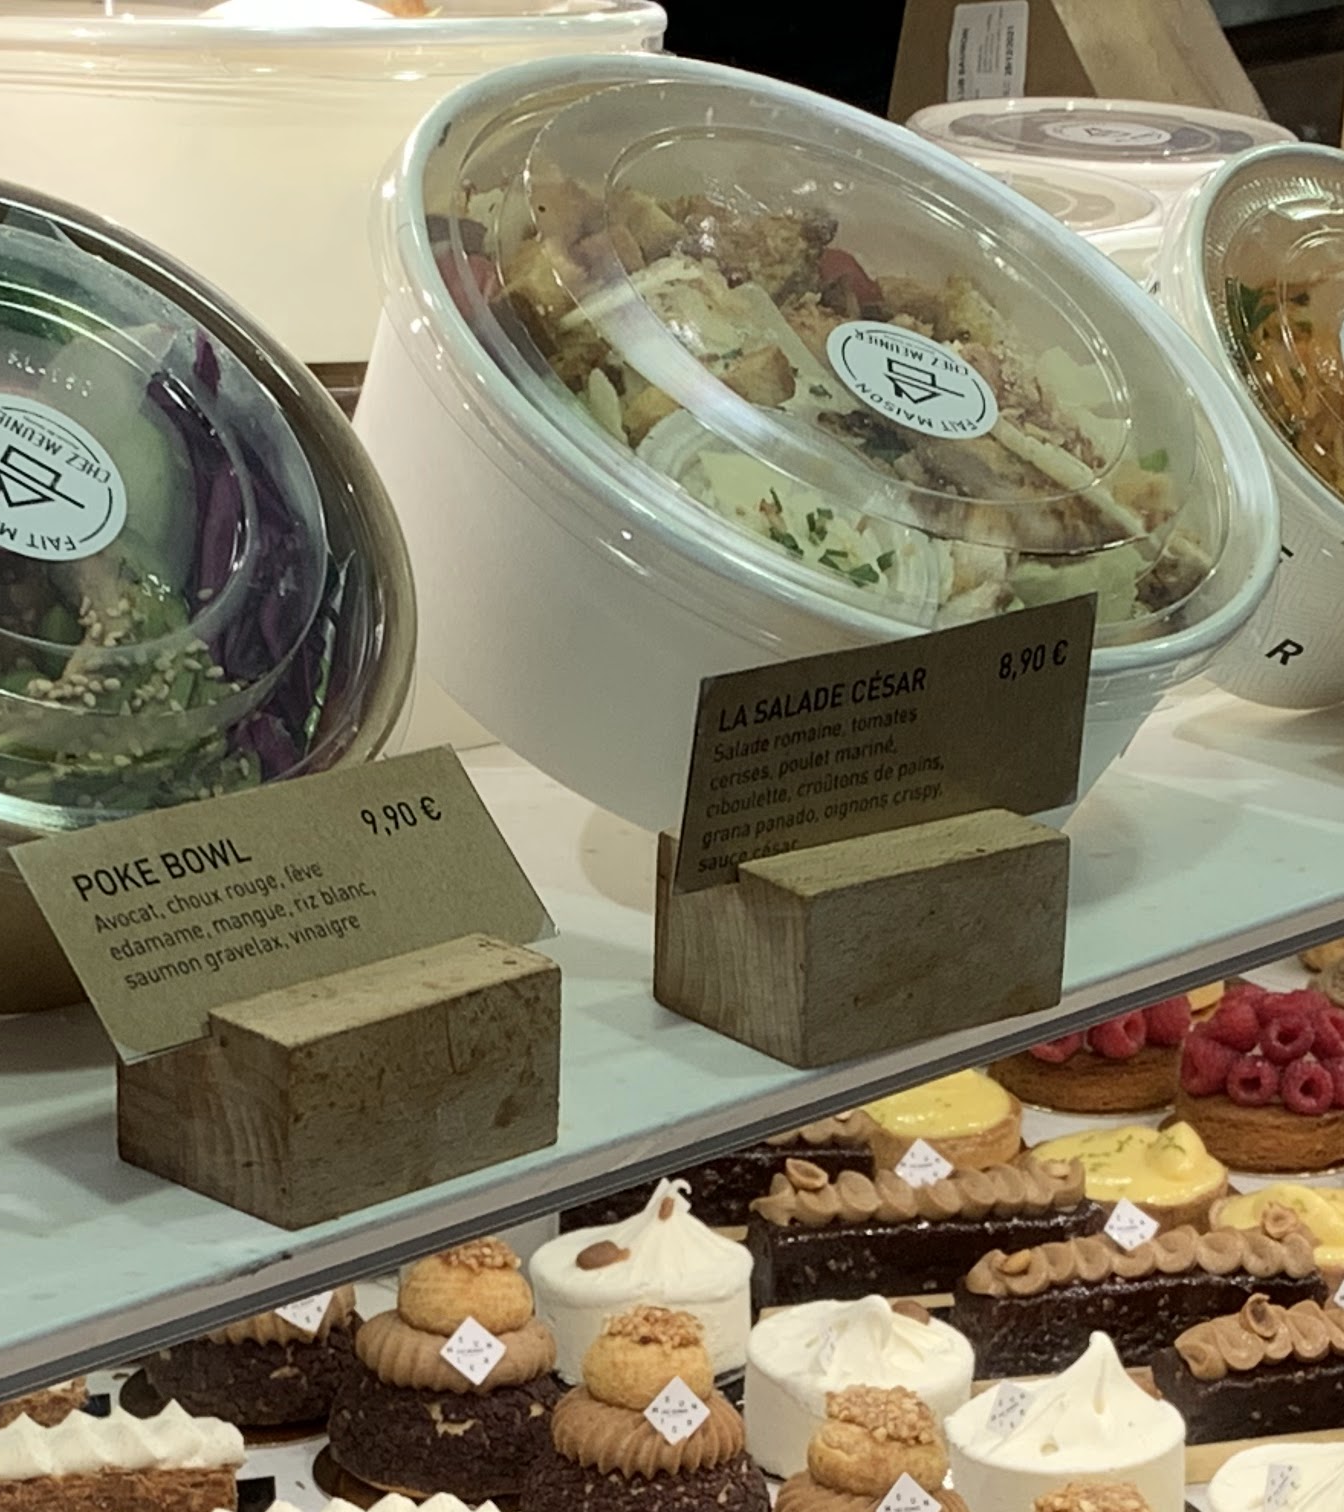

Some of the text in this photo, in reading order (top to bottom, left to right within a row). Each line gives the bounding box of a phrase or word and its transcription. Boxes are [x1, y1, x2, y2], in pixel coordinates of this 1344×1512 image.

[854, 328, 924, 363] MEUNIER
[930, 353, 969, 376] CHEZ
[855, 382, 978, 433] FAIT MAISON
[64, 451, 112, 485] CHEZ
[26, 533, 78, 552] FAIT
[998, 639, 1068, 681] 8,90 €
[1264, 638, 1305, 666] R
[717, 667, 927, 733] LA SALADE CÉSAR
[713, 705, 918, 763] Salade romaine, tomates
[706, 786, 793, 819] ciboulette,
[796, 768, 870, 800] croûtons
[873, 762, 894, 783] de
[709, 765, 774, 792] cerises,
[778, 748, 830, 783] poulet
[360, 796, 443, 837] 9,90 €
[701, 824, 751, 850] grana
[823, 793, 889, 826] oignons
[891, 781, 944, 811] crispy,
[71, 836, 252, 902] POKE BOWL
[697, 850, 748, 874] sauce
[94, 861, 324, 934] Avocat, choux rouge, fève
[109, 878, 378, 963] edamame, mangue, riz blanc,
[125, 913, 362, 991] saumon gravelax, vinaigre
